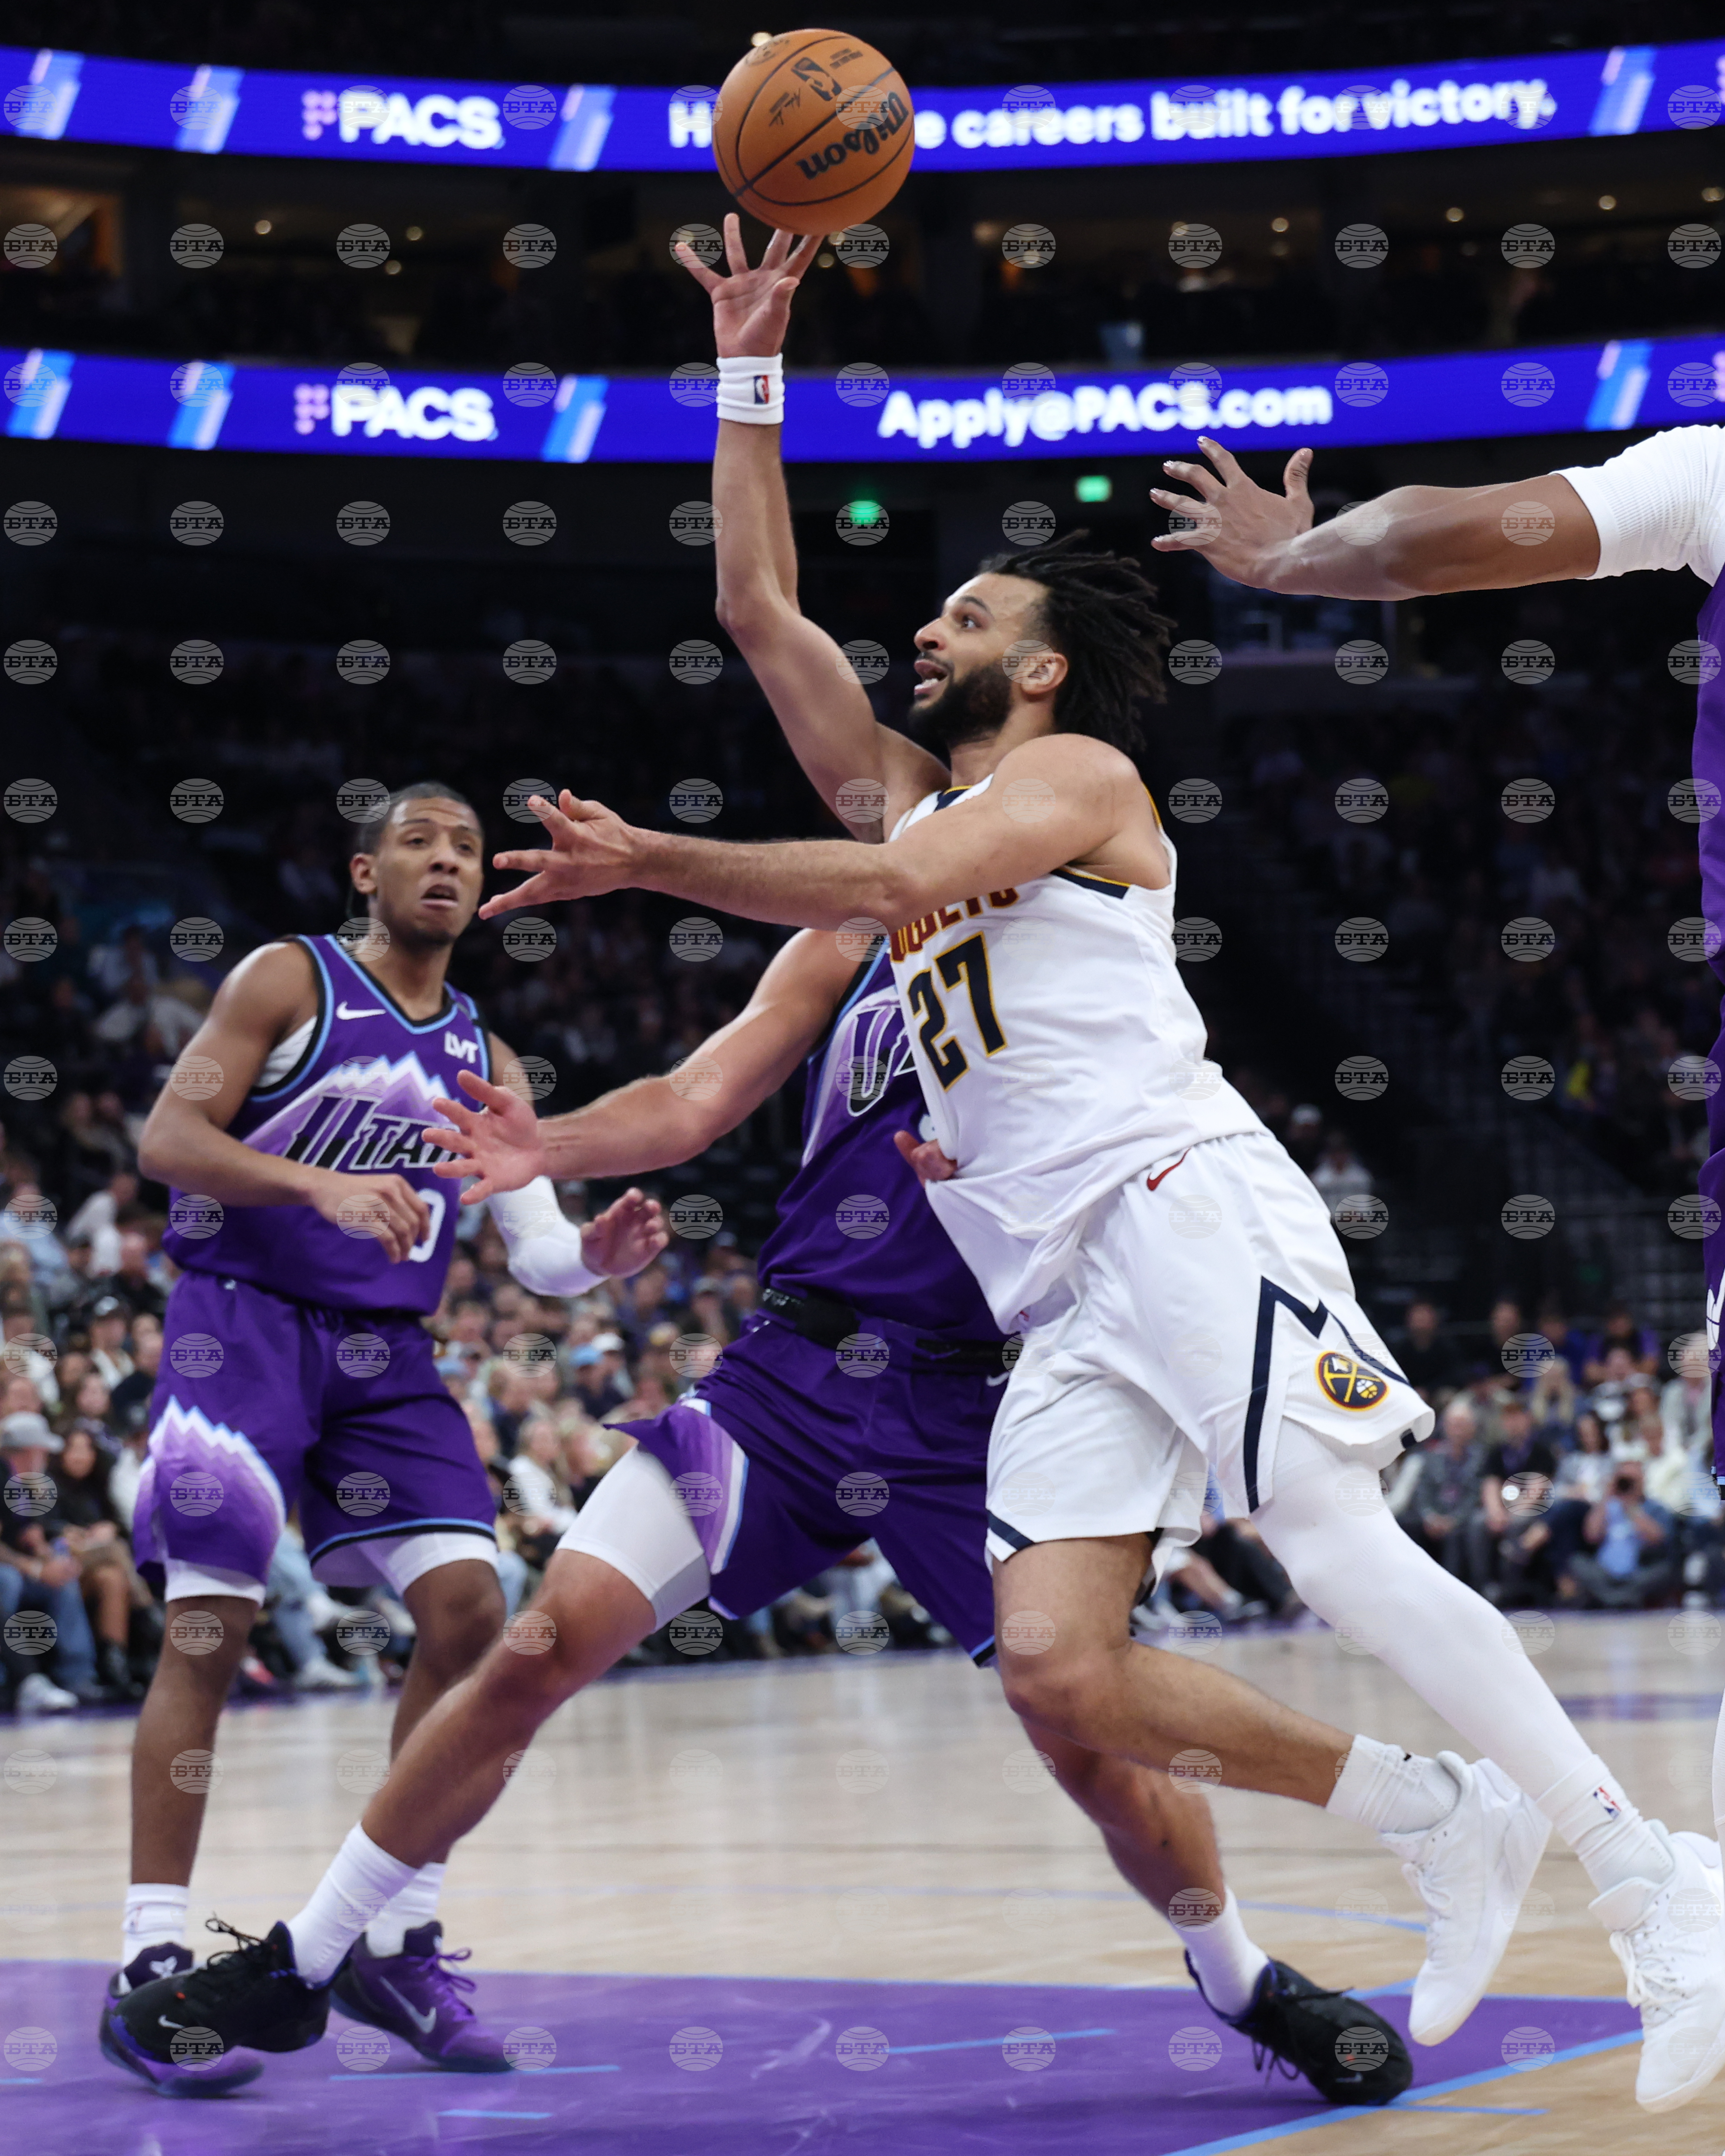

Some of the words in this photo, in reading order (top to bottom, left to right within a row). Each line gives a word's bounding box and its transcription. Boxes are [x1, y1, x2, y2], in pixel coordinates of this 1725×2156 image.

[339, 90, 502, 149] PACS
[796, 91, 909, 180] Wilson
[951, 104, 1145, 148] careers
[1150, 89, 1274, 140] built
[1277, 85, 1353, 135] for
[1361, 78, 1557, 130] victory.
[331, 384, 495, 441] PACS
[878, 380, 1333, 449] Apply@PACS.com
[907, 931, 1008, 1093] 27
